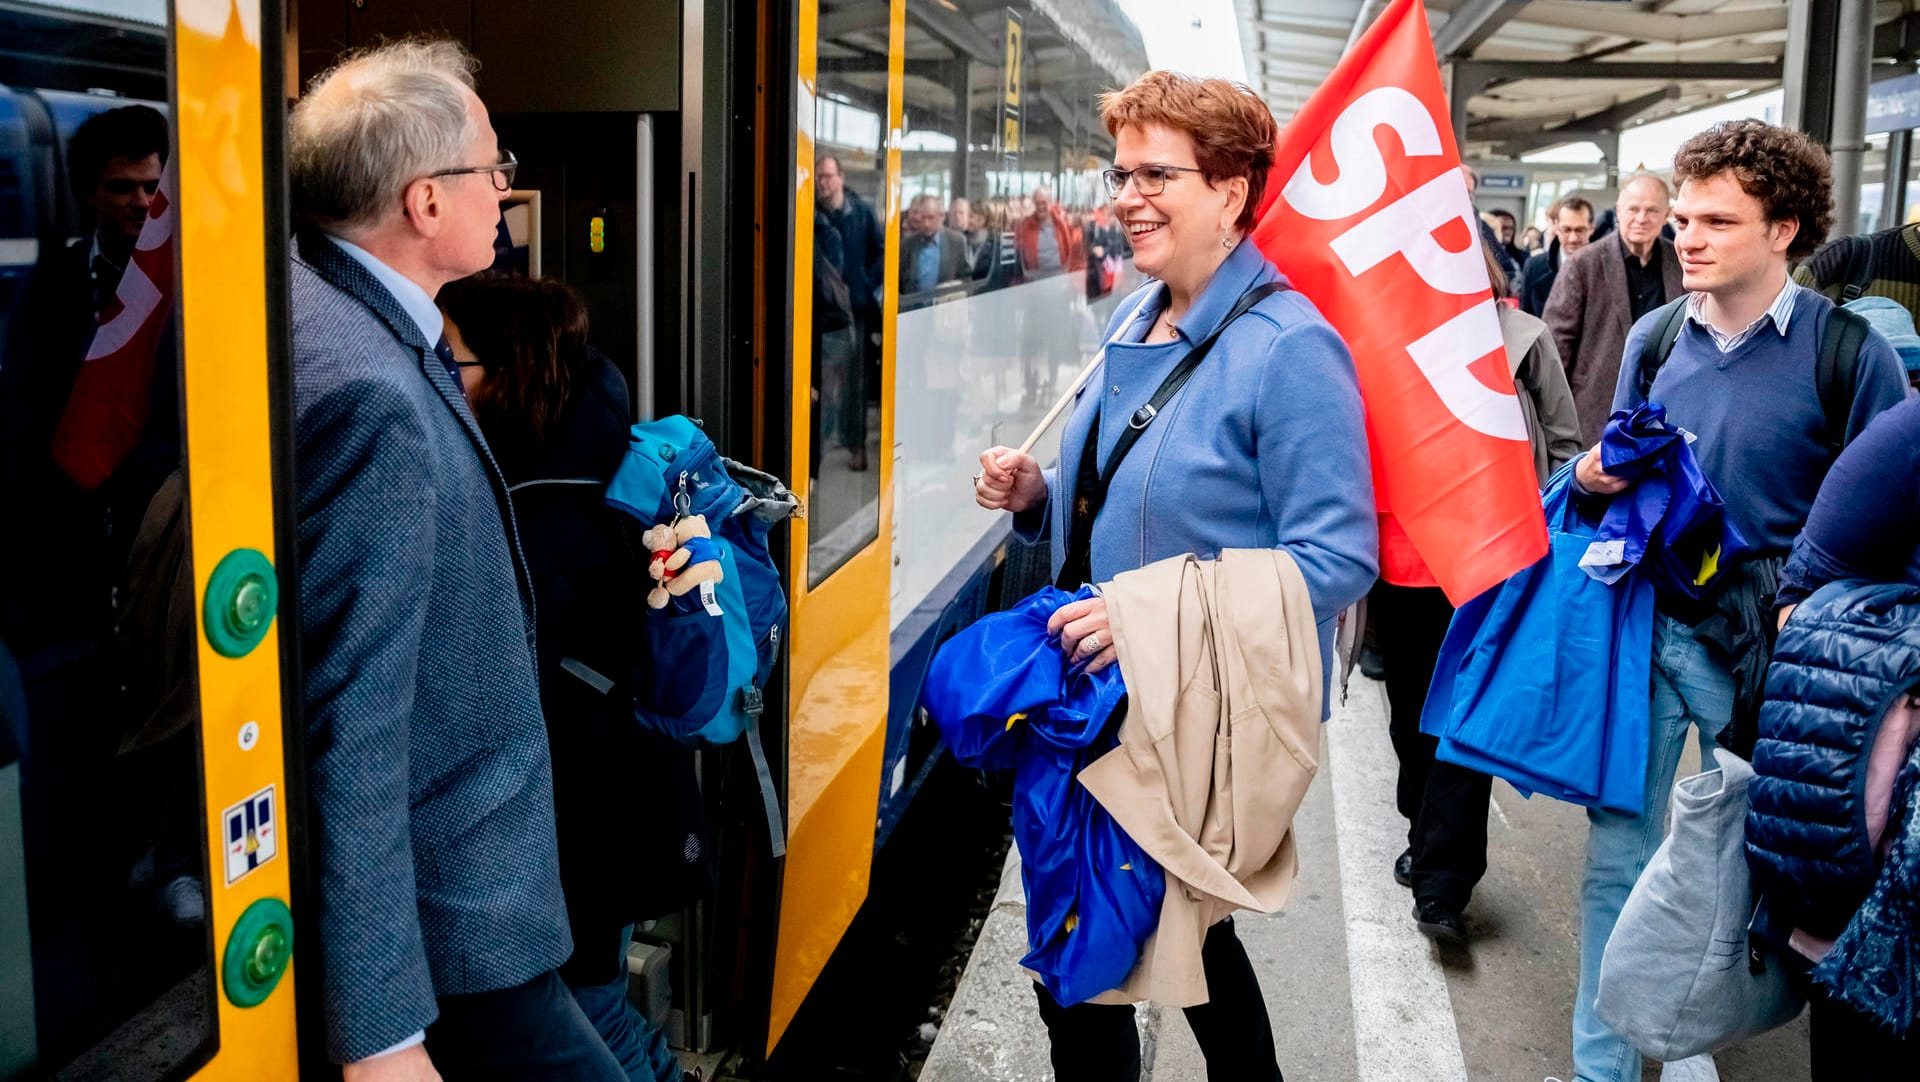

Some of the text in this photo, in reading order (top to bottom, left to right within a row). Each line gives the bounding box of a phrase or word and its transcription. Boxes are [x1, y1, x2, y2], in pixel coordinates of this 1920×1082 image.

[1009, 31, 1018, 94] 2
[1281, 86, 1529, 441] SPD
[243, 726, 253, 743] 6
